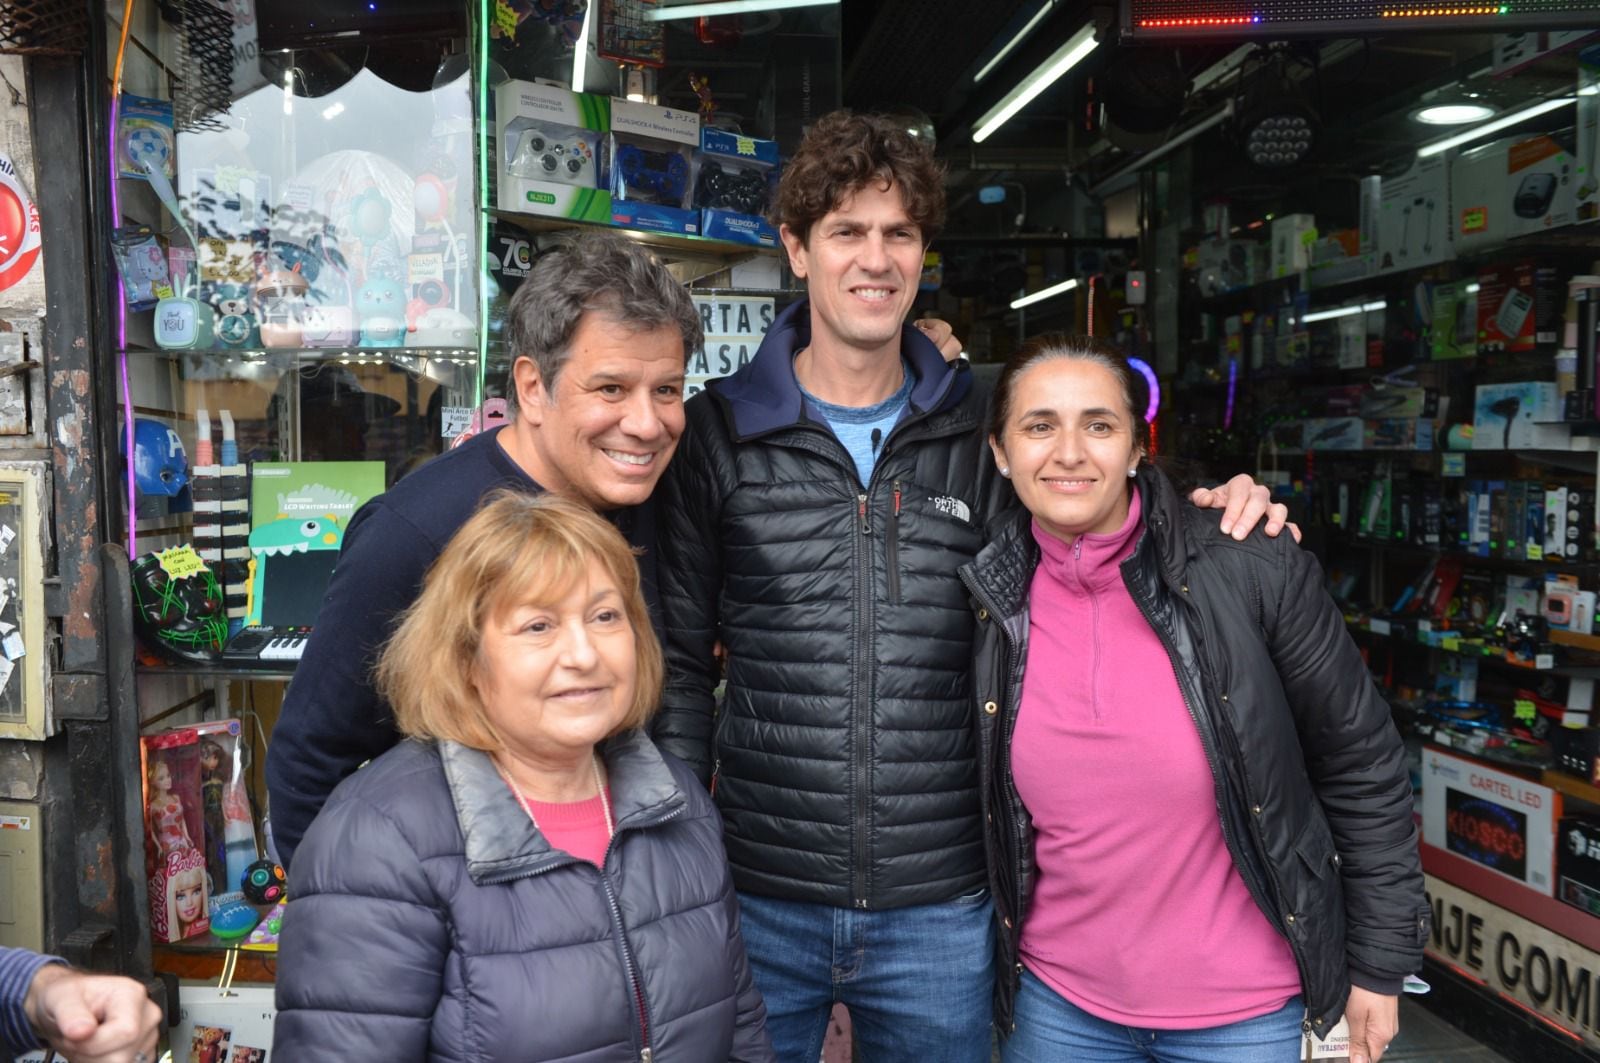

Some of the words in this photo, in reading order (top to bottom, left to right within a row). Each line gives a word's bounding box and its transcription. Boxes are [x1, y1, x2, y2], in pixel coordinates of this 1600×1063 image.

[674, 113, 697, 124] PS4
[163, 319, 184, 332] YOU
[683, 343, 750, 375] ASA
[284, 503, 298, 511] LCD
[1469, 773, 1515, 801] CARTEL
[1518, 789, 1542, 809] LED
[167, 848, 205, 877] Barbie
[1496, 931, 1600, 1037] COM
